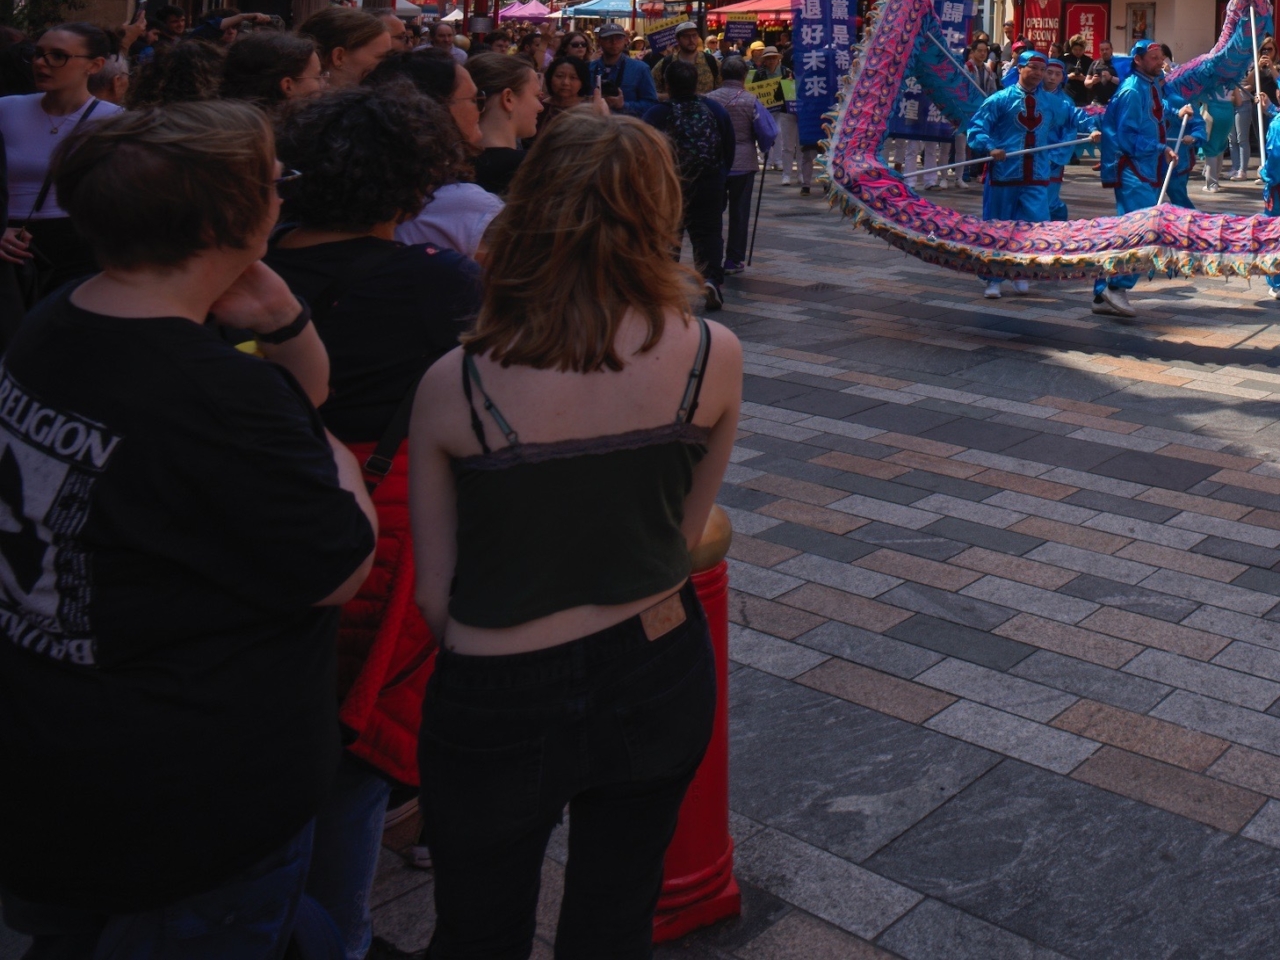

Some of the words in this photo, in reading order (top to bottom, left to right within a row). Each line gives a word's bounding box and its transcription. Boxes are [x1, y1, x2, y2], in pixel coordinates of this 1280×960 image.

[1026, 18, 1059, 29] OPENING
[1033, 30, 1051, 41] SOON
[755, 89, 772, 100] alun
